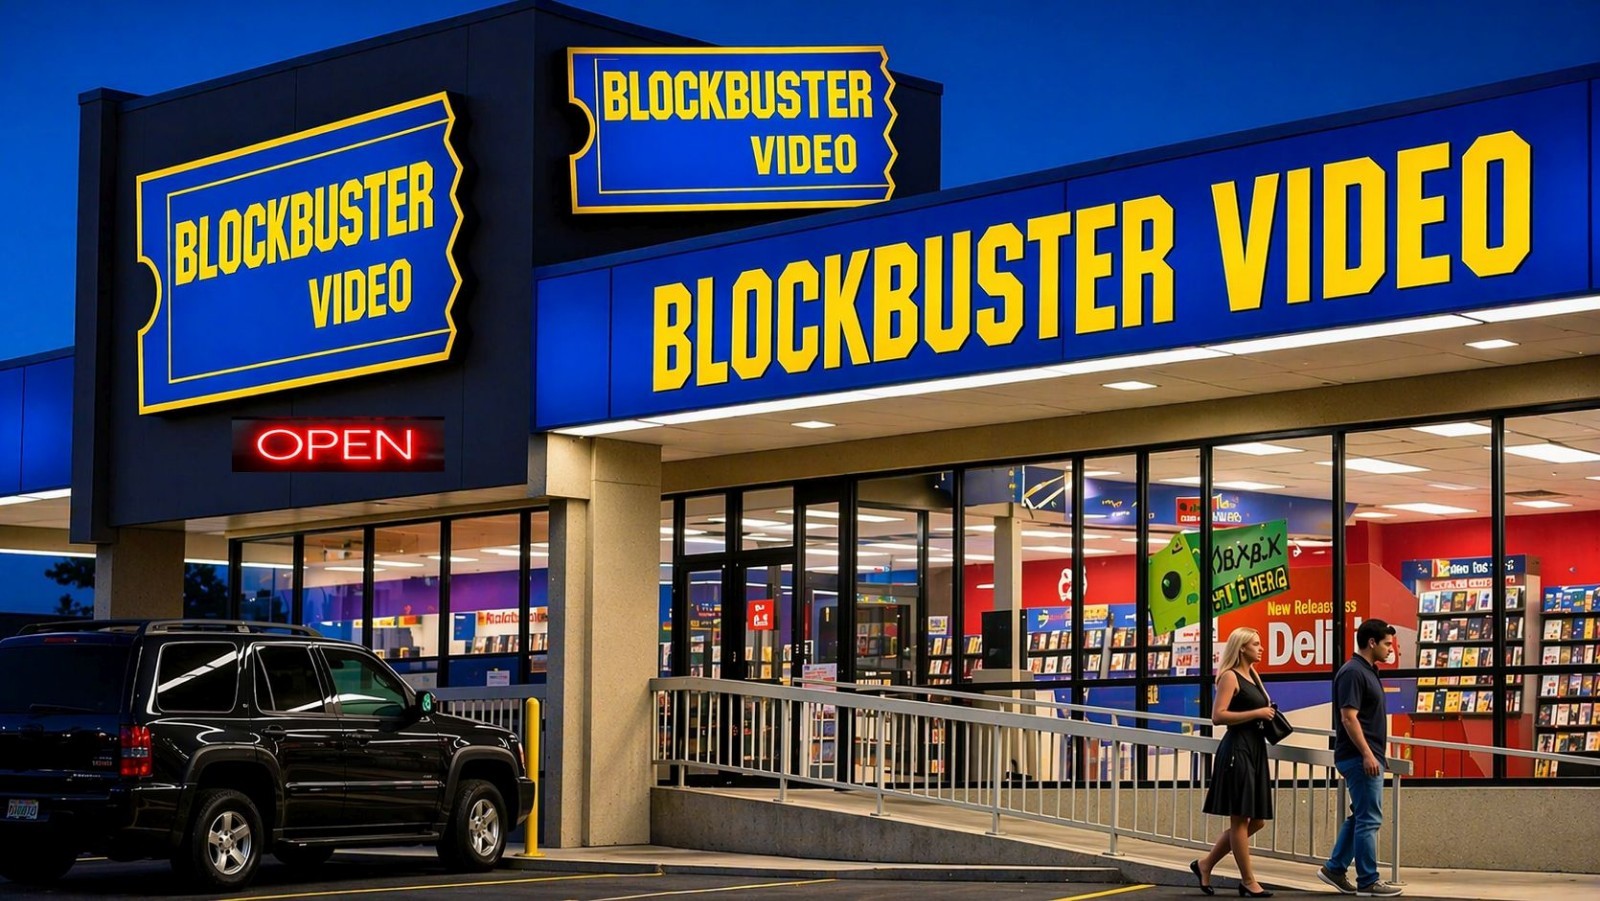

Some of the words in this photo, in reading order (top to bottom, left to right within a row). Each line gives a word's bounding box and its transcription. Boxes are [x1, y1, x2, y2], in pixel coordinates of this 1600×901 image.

[602, 70, 873, 121] BLOCKBUSTER
[750, 134, 857, 175] VIDEO
[174, 160, 434, 286] BLOCKBUSTER
[652, 194, 1174, 392] BLOCKBUSTER
[1211, 130, 1532, 312] VIDEO
[308, 258, 412, 329] VIDEO
[257, 429, 412, 460] OPEN
[1267, 601, 1291, 616] New
